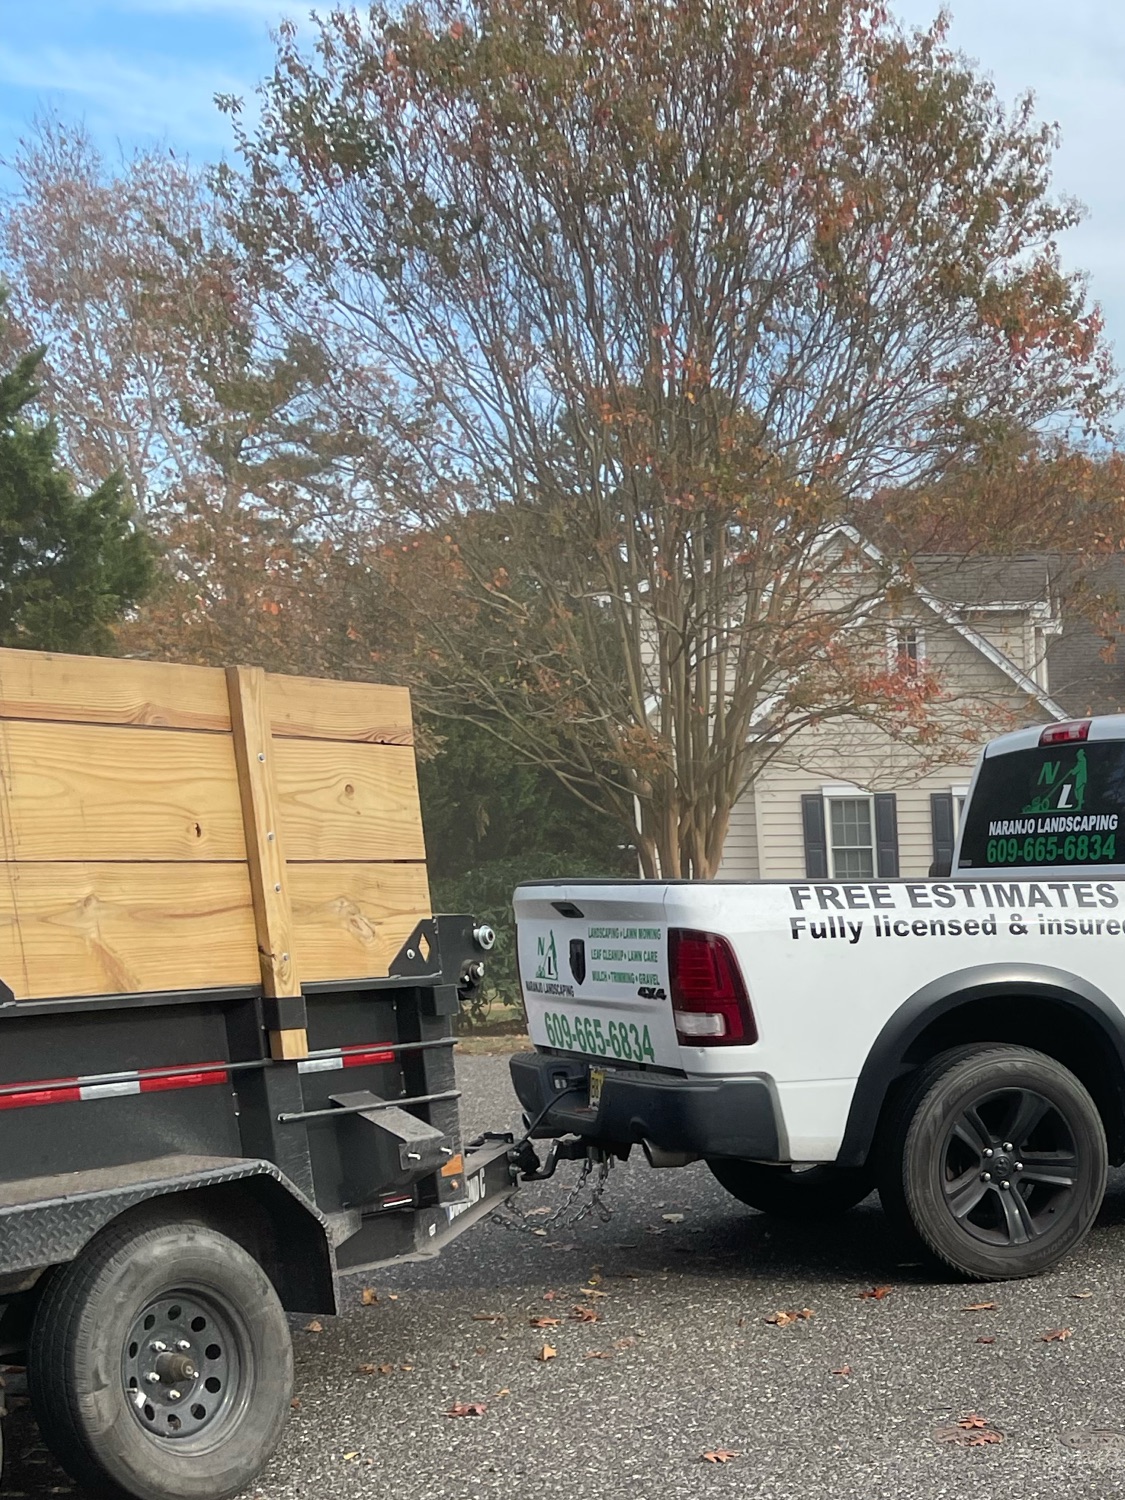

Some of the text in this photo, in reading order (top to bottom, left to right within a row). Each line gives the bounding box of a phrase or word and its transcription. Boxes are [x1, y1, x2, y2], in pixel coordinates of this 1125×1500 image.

[1037, 761, 1061, 785] N
[1056, 784, 1073, 809] L
[988, 814, 1119, 836] NARANJO LANDSCAPING
[986, 834, 1116, 863] 609-665-6834
[789, 882, 1119, 910] FREE ESTIMATES
[588, 926, 620, 939] LANDSCAPING
[622, 927, 638, 940] LAWN
[789, 914, 864, 944] Fully
[873, 913, 997, 938] licensed
[1008, 912, 1029, 936] &
[547, 956, 554, 976] L
[591, 948, 602, 960] LEAF
[627, 950, 642, 962] LAWN
[643, 950, 658, 963] CARE
[544, 982, 575, 998] LANDSCAPING
[638, 972, 660, 986] GRAVEL
[544, 1012, 655, 1063] 609-665-6834
